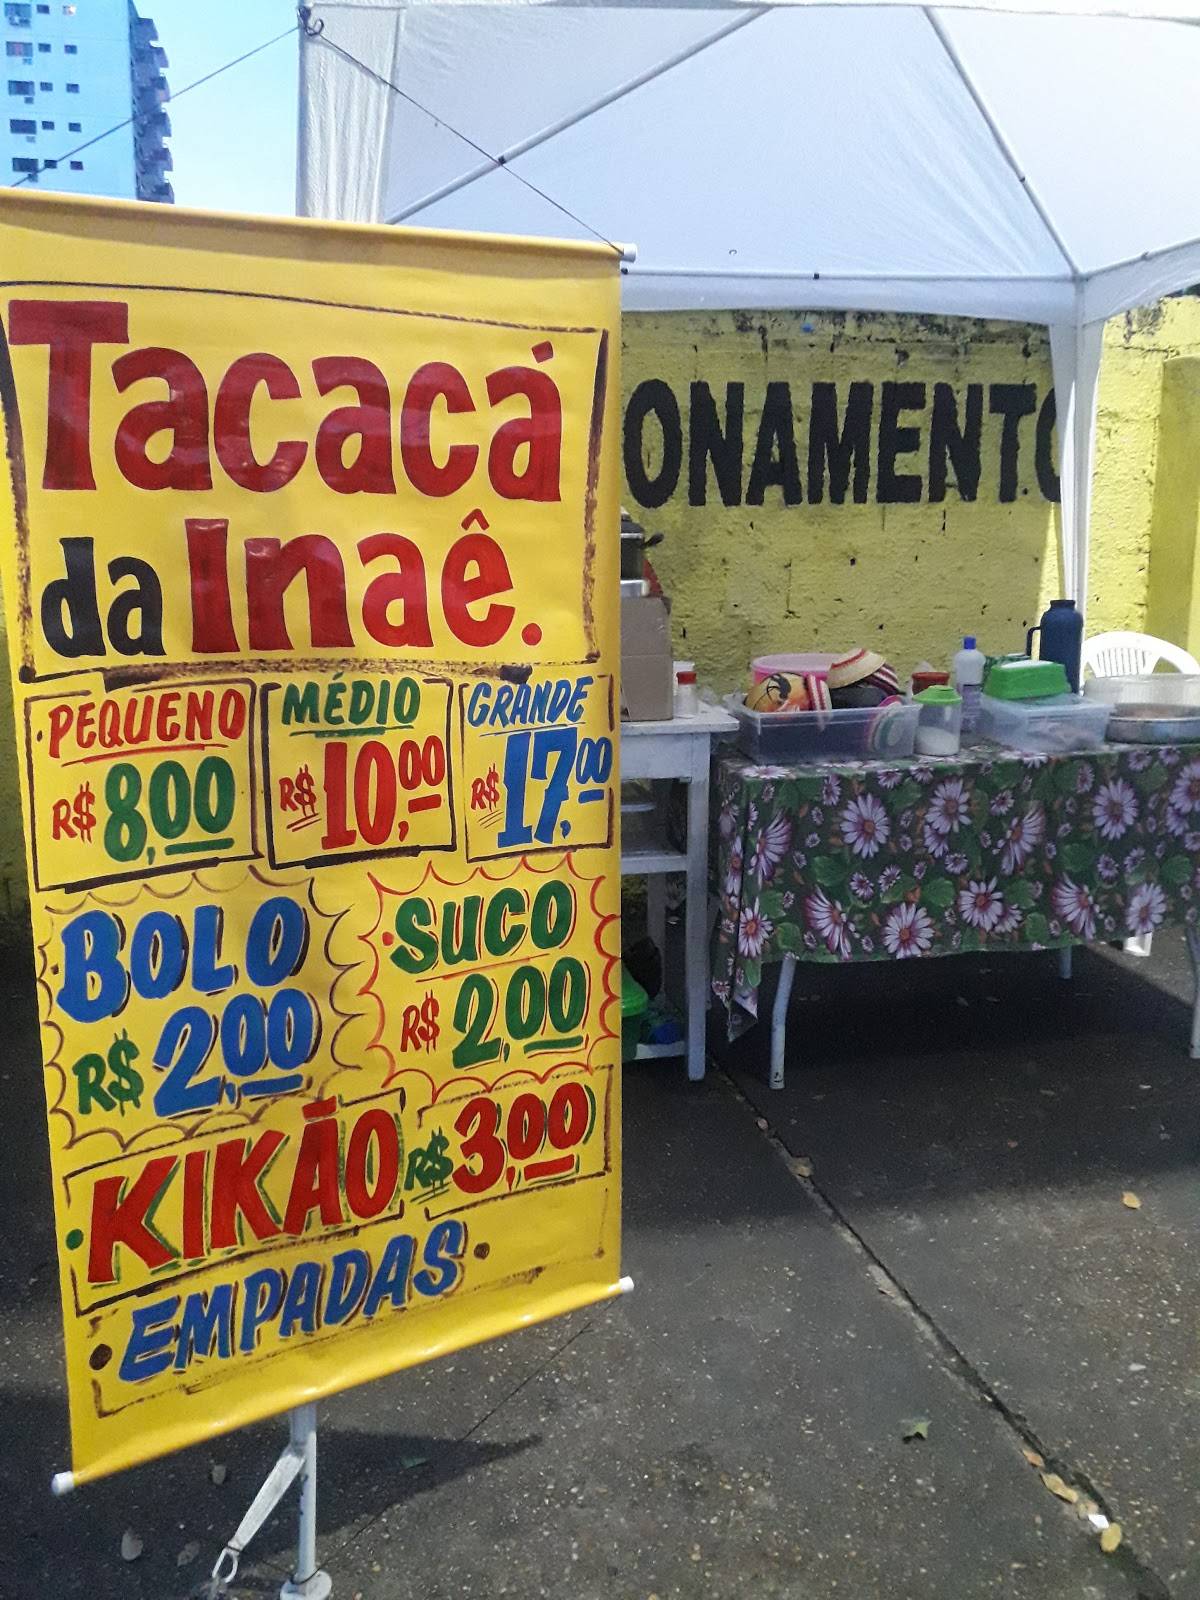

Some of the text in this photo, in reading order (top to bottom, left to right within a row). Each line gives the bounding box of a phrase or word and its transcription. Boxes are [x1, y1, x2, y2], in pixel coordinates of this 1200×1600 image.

[8, 300, 563, 502] Tacacá
[41, 508, 543, 658] da Inaê.
[48, 689, 247, 758] PEQUENO
[281, 674, 421, 726] MÉDIO
[466, 675, 594, 728] GRANDE
[52, 756, 236, 865] R$ 8,00
[278, 764, 320, 821] R$
[470, 763, 501, 812] R$
[56, 896, 308, 1024] BOLO
[389, 879, 578, 975] SUCO
[71, 988, 316, 1117] R$ 2,00
[400, 956, 588, 1070] R$ 2,00
[87, 1081, 590, 1286] KIKÃO R$ 3,00
[117, 1219, 466, 1383] EMPADAS
